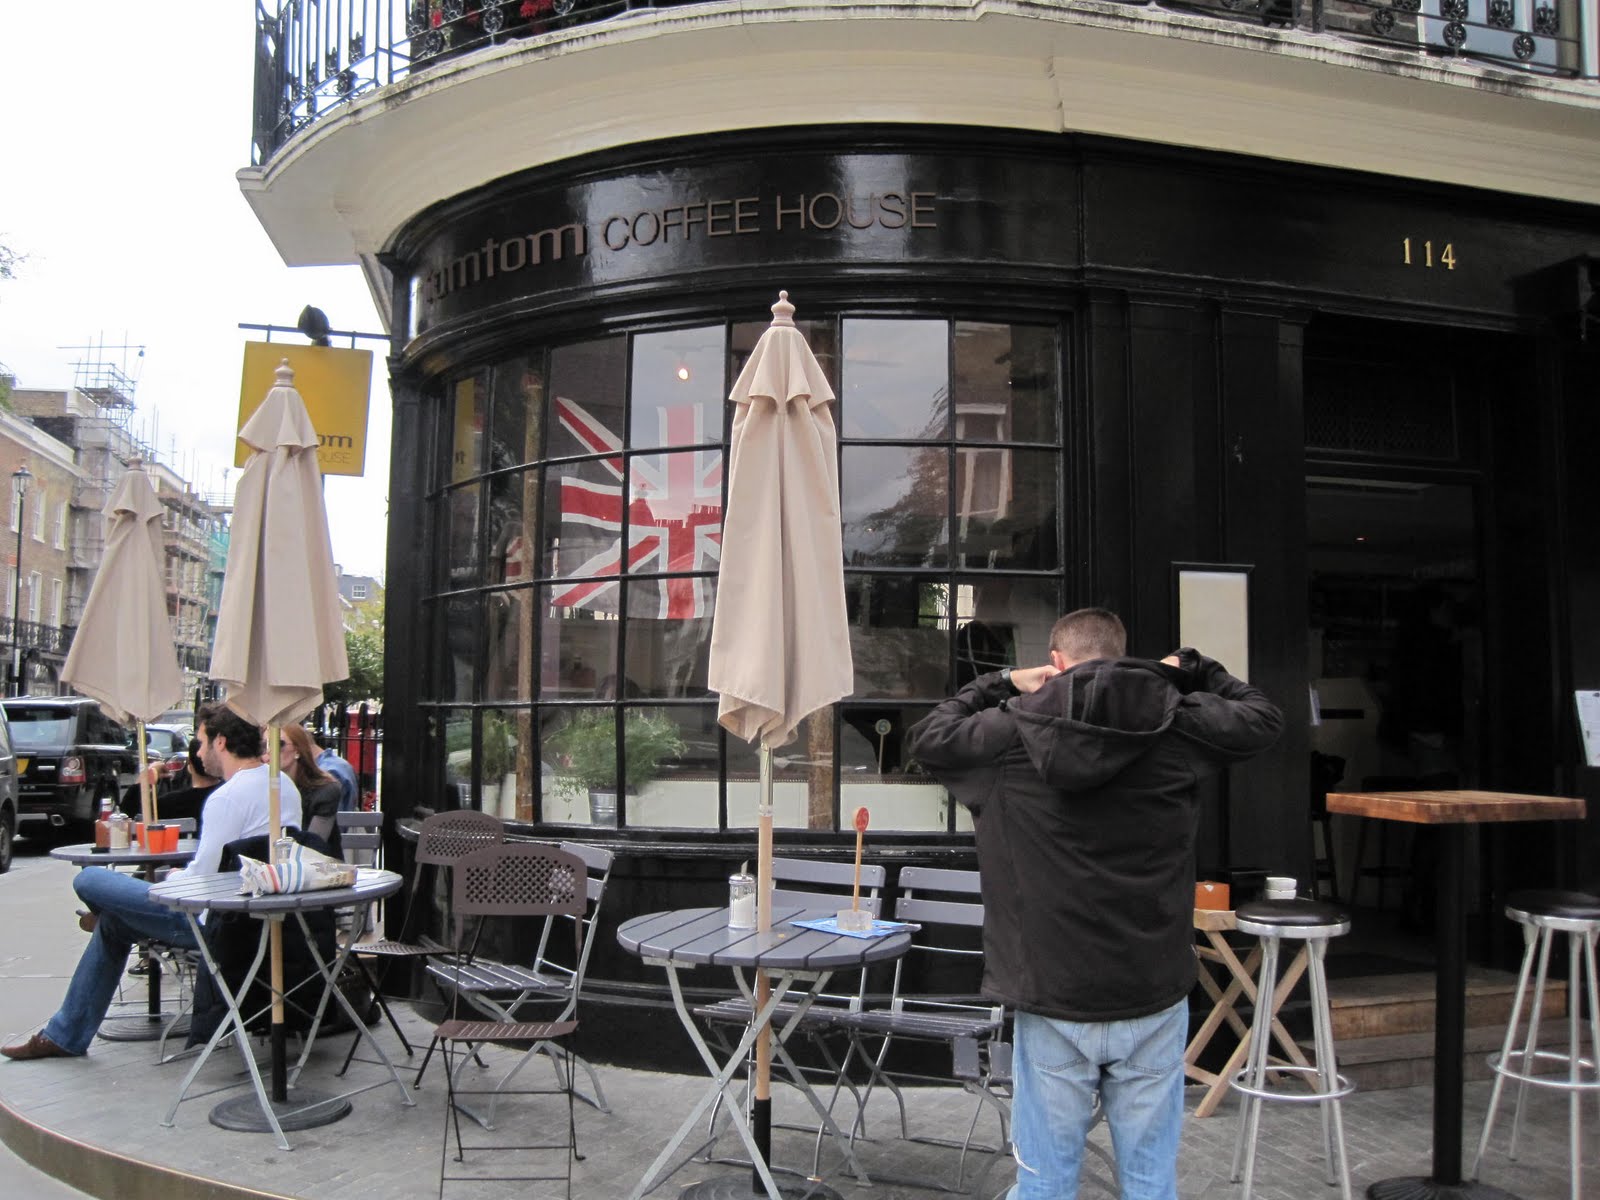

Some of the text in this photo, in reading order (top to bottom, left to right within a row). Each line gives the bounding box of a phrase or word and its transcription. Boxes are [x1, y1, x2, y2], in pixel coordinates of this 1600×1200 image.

[601, 197, 760, 251] COFFEE
[776, 192, 937, 230] HOUSE
[1403, 237, 1456, 269] 114
